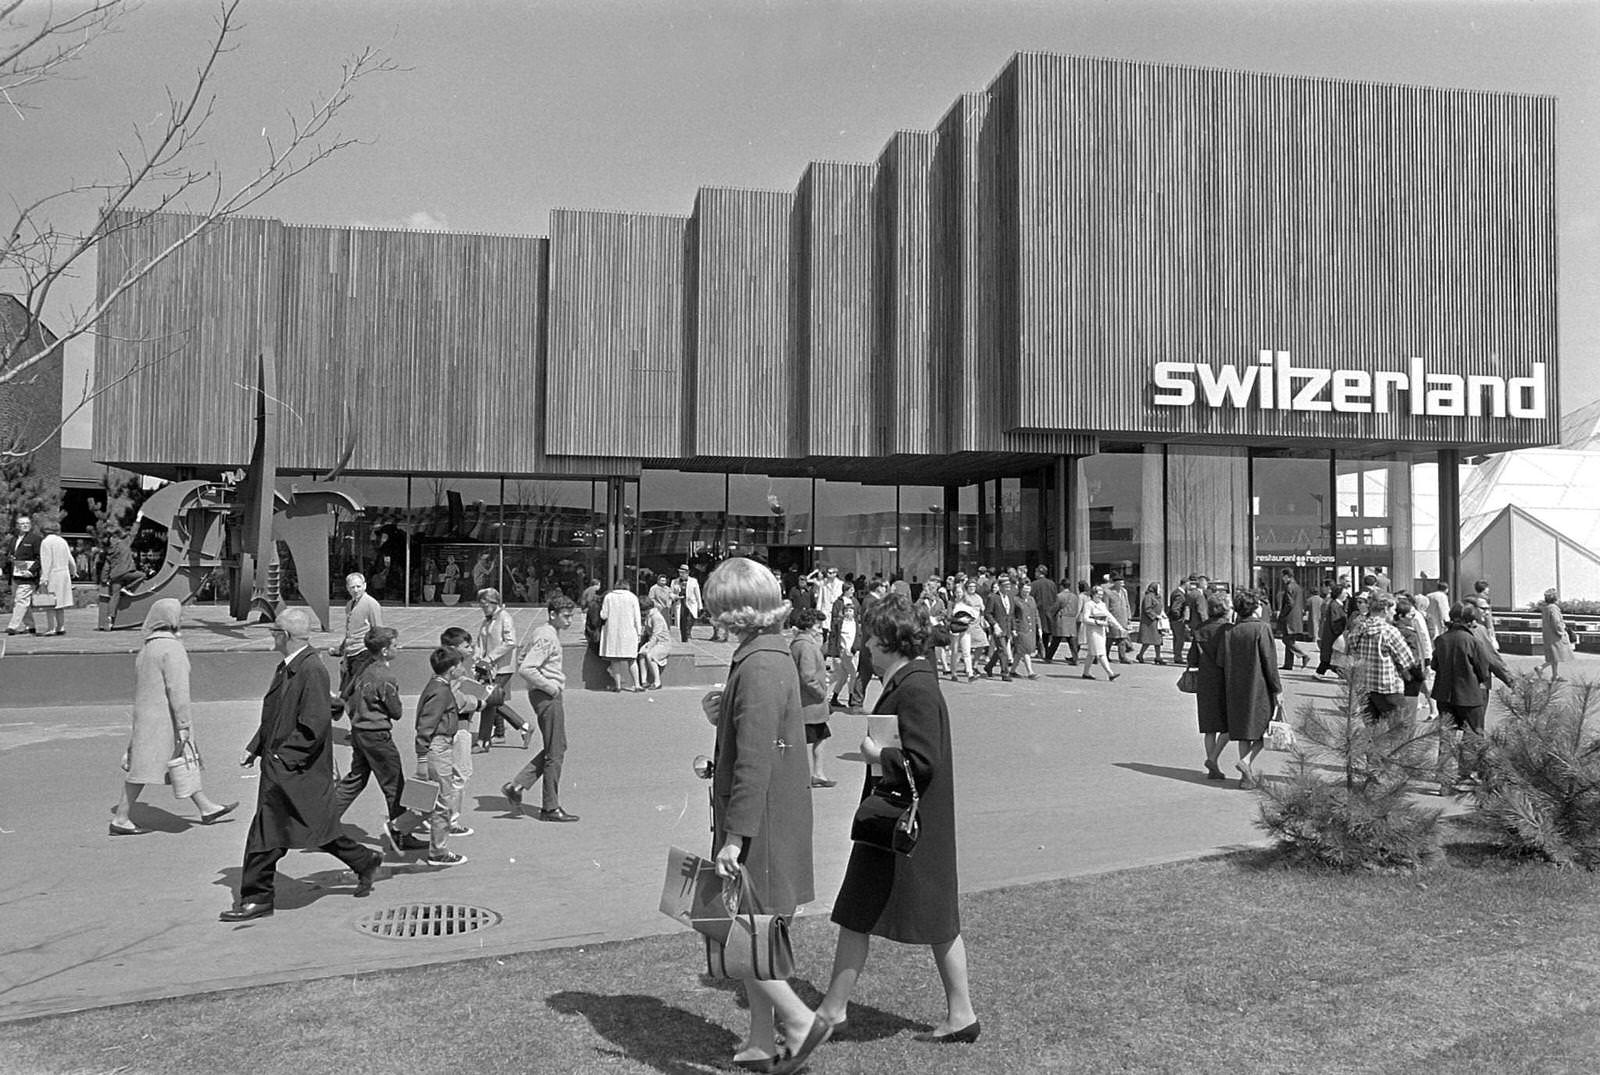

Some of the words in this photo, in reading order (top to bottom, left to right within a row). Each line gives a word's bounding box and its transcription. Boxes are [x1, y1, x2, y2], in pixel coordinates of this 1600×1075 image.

[1154, 349, 1546, 419] switzerland
[1255, 554, 1296, 562] restaurant
[1306, 554, 1336, 563] regions
